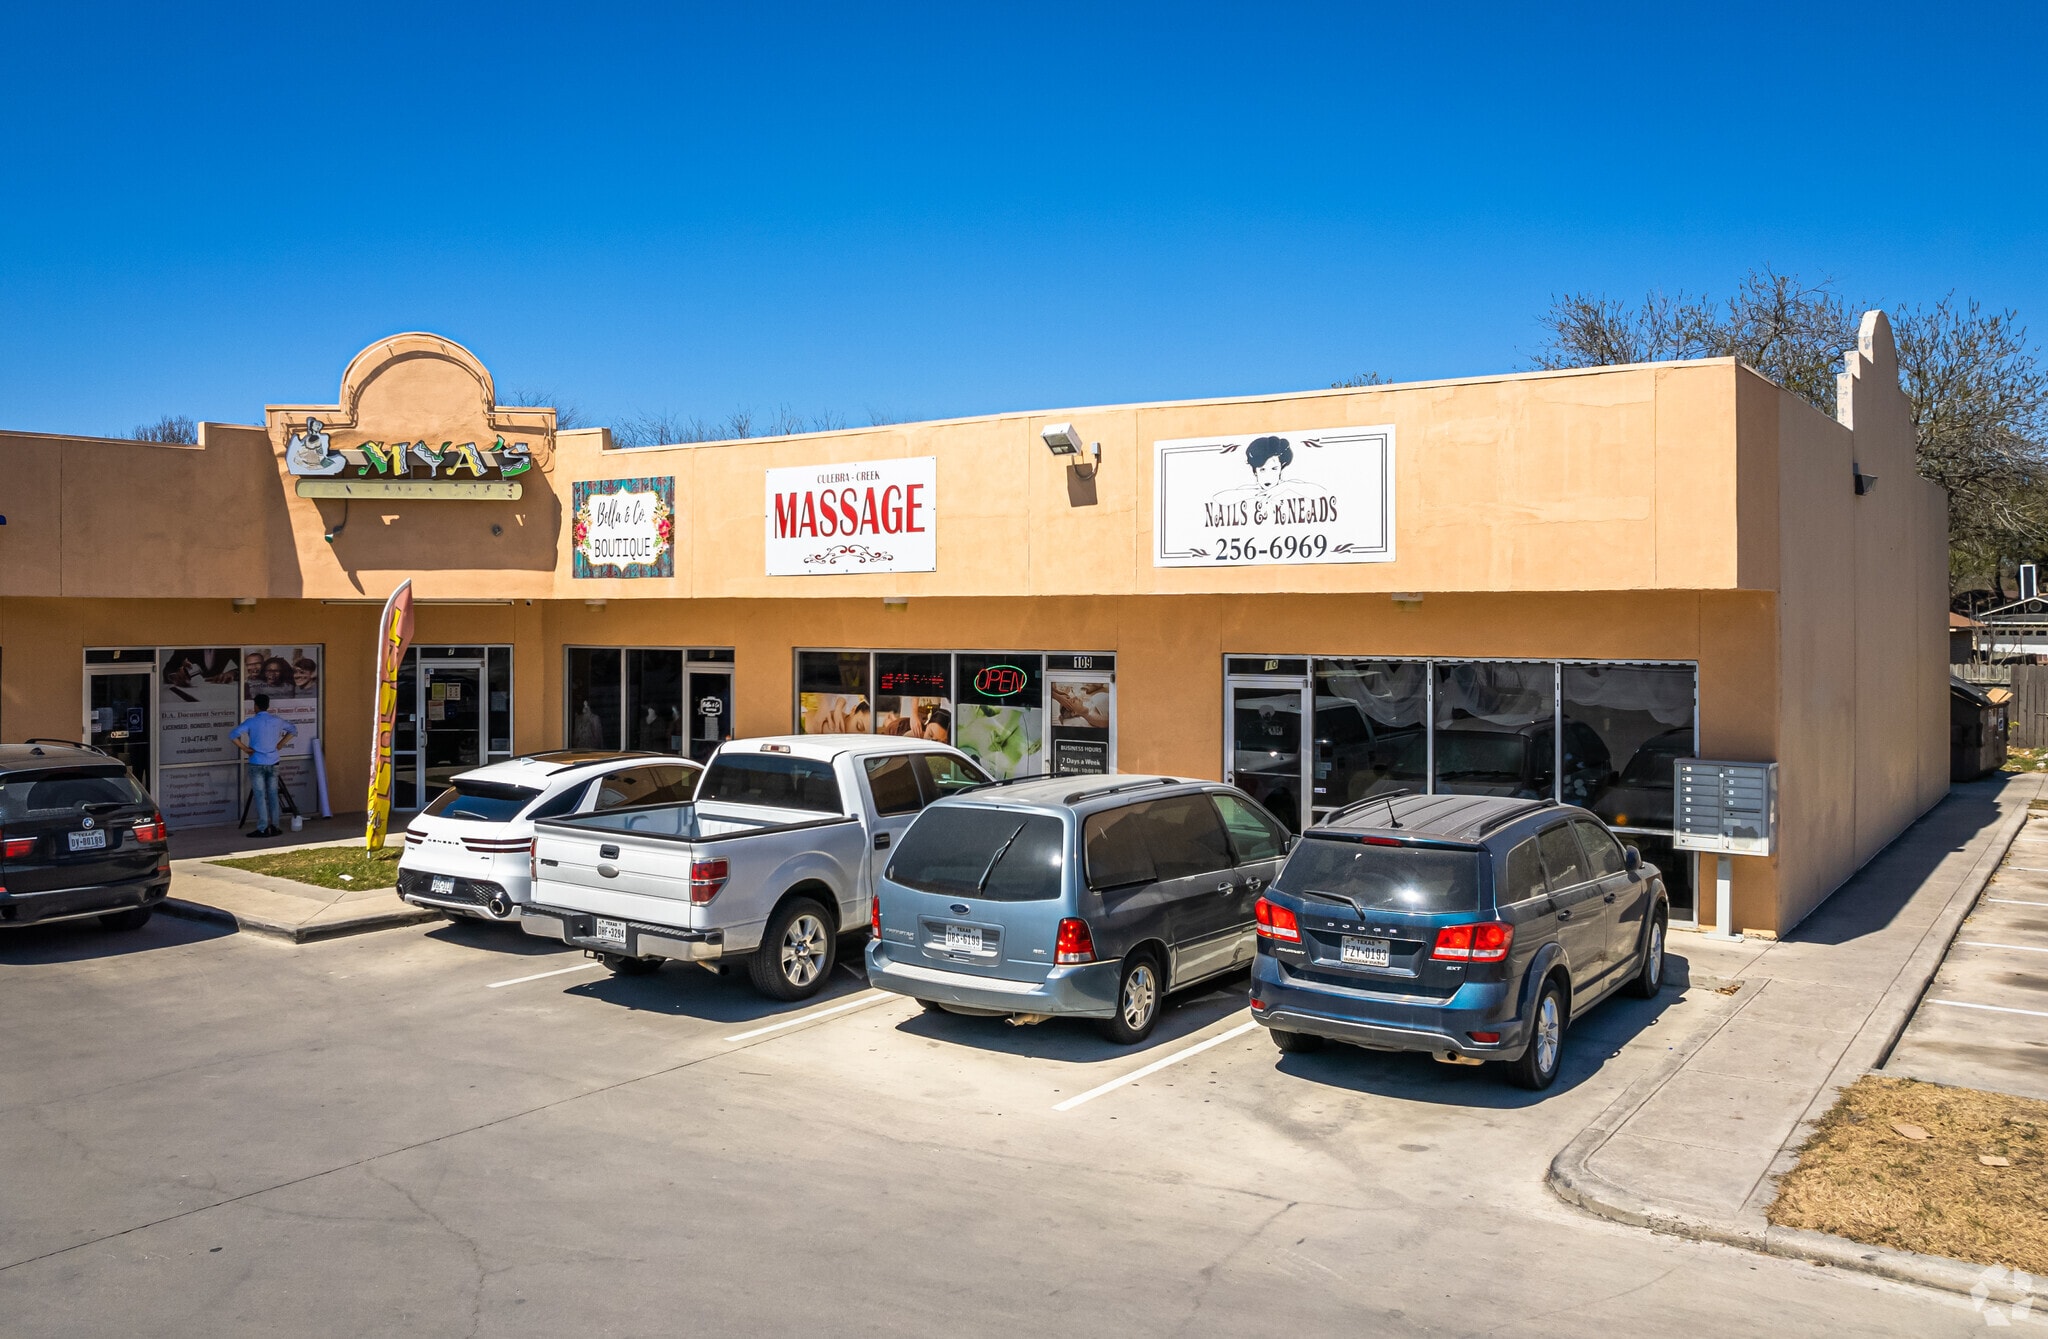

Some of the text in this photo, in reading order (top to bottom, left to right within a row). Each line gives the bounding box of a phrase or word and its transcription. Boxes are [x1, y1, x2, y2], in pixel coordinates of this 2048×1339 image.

[356, 434, 532, 478] MYA'S
[817, 472, 850, 484] CULEBRA
[856, 470, 880, 482] CREEK
[597, 499, 621, 529] Bella
[625, 506, 630, 523] &
[774, 483, 926, 539] MASSAGE
[1204, 495, 1338, 528] NAILS & KNEADS
[594, 537, 651, 560] BOUTIQUE
[1215, 534, 1328, 561] 256-6969
[1073, 656, 1093, 669] 109
[1265, 660, 1278, 671] 10
[976, 668, 1024, 693] OPEN
[177, 710, 209, 718] Document
[209, 709, 235, 717] Services
[1060, 744, 1084, 752] BUSINESS
[1066, 758, 1080, 766] Days
[1327, 922, 1398, 934] DODGE
